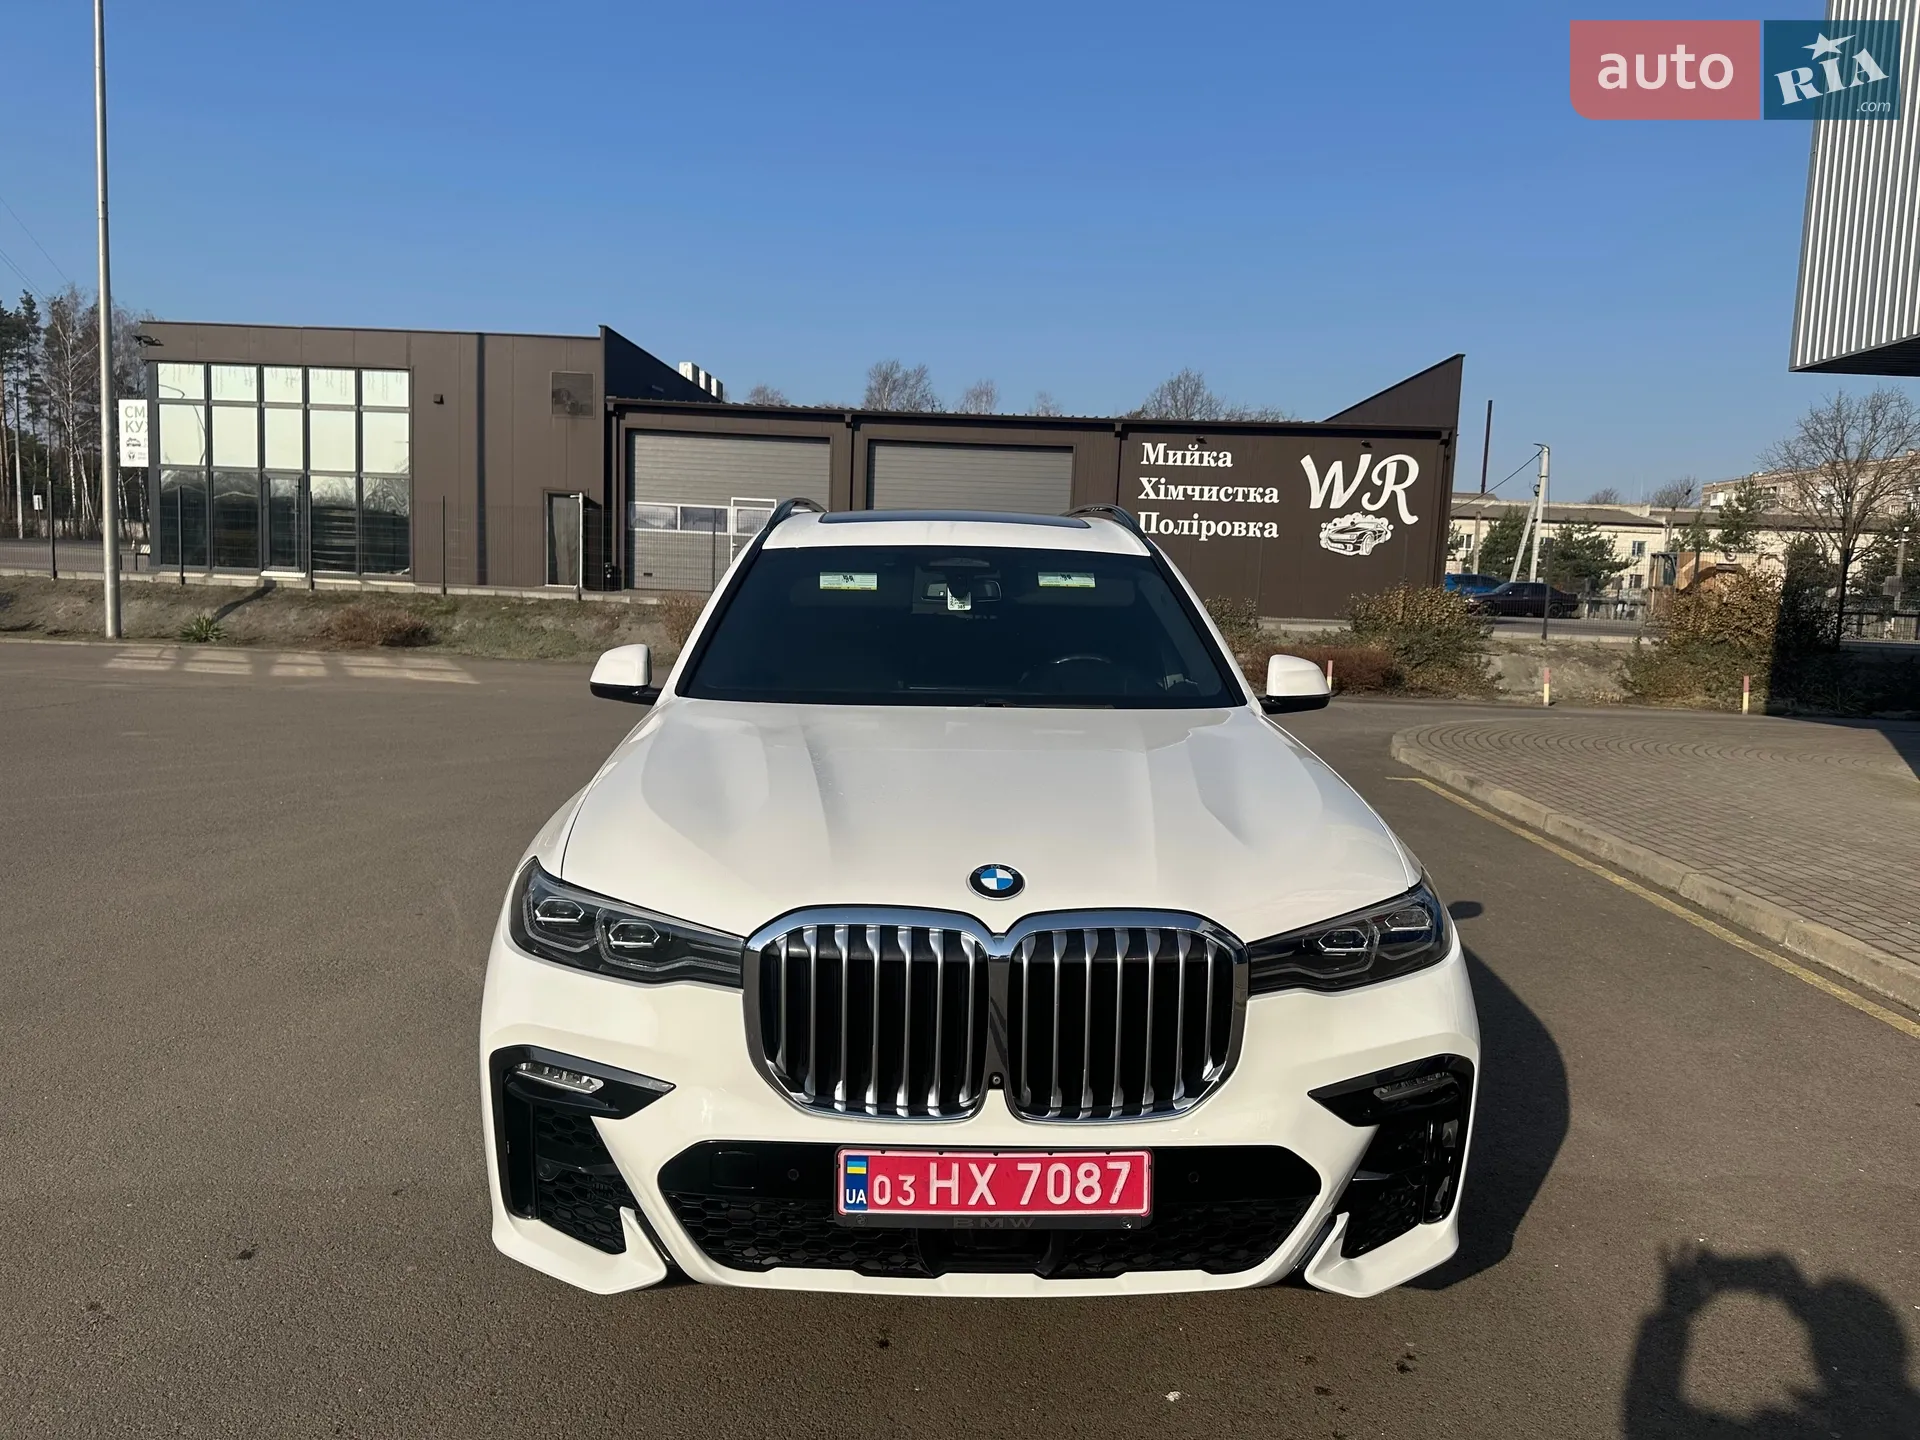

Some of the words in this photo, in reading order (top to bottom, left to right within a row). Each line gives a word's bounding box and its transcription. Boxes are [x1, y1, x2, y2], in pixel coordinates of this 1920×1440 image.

[127, 406, 148, 418] СМ
[1140, 442, 1233, 468] Мийка
[1138, 477, 1280, 504] Хімчистка
[1300, 453, 1420, 525] WR
[1138, 511, 1280, 541] Поліровка
[872, 1175, 917, 1206] 03
[928, 1162, 997, 1206] HX
[1016, 1161, 1132, 1206] 7087
[846, 1189, 867, 1205] UA
[952, 1217, 1036, 1229] BMW
